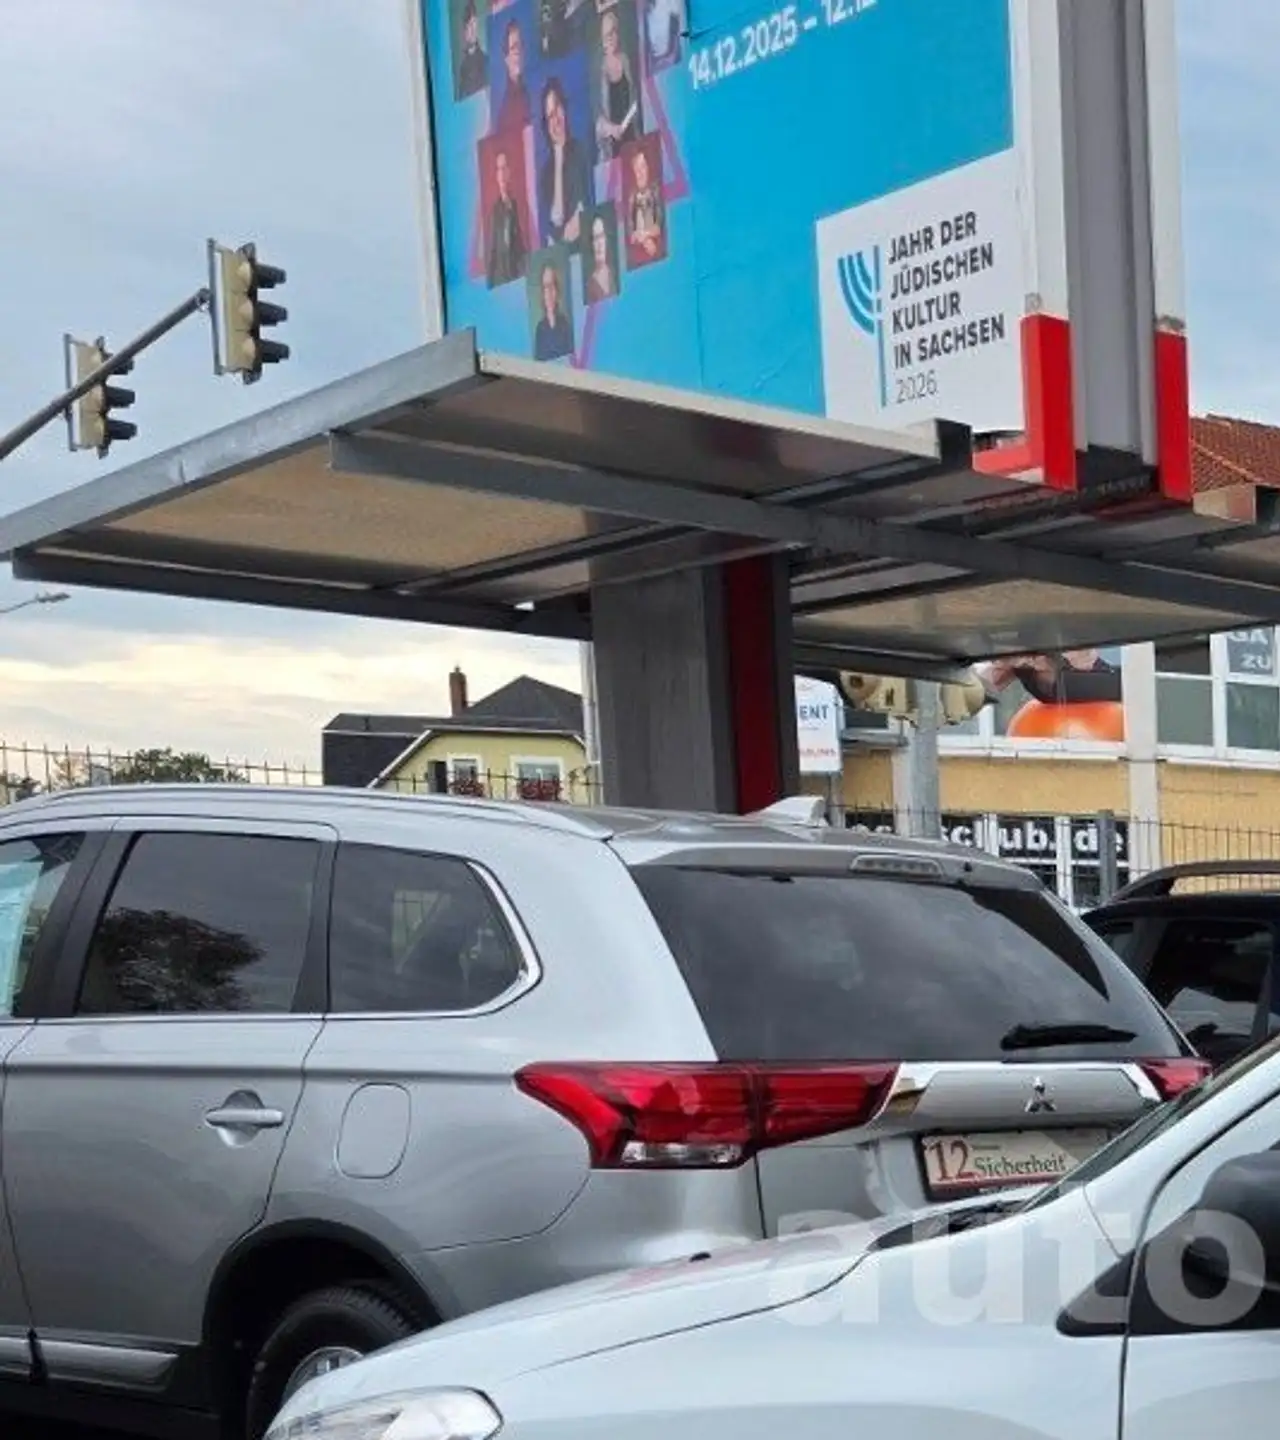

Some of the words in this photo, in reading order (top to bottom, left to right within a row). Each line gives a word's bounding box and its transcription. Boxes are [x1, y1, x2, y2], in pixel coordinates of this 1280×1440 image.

[689, 5, 799, 89] 14.12.2025
[889, 226, 934, 264] JAHR
[940, 211, 977, 246] DER
[890, 242, 994, 300] JÜDISCHEN
[892, 291, 961, 334] KULTUR
[894, 340, 911, 369] IN
[918, 313, 1005, 361] SACHSEN
[896, 369, 937, 404] 2026
[799, 704, 829, 720] ENT
[929, 1140, 974, 1179] 12
[974, 1154, 1067, 1174] Sicherheit
